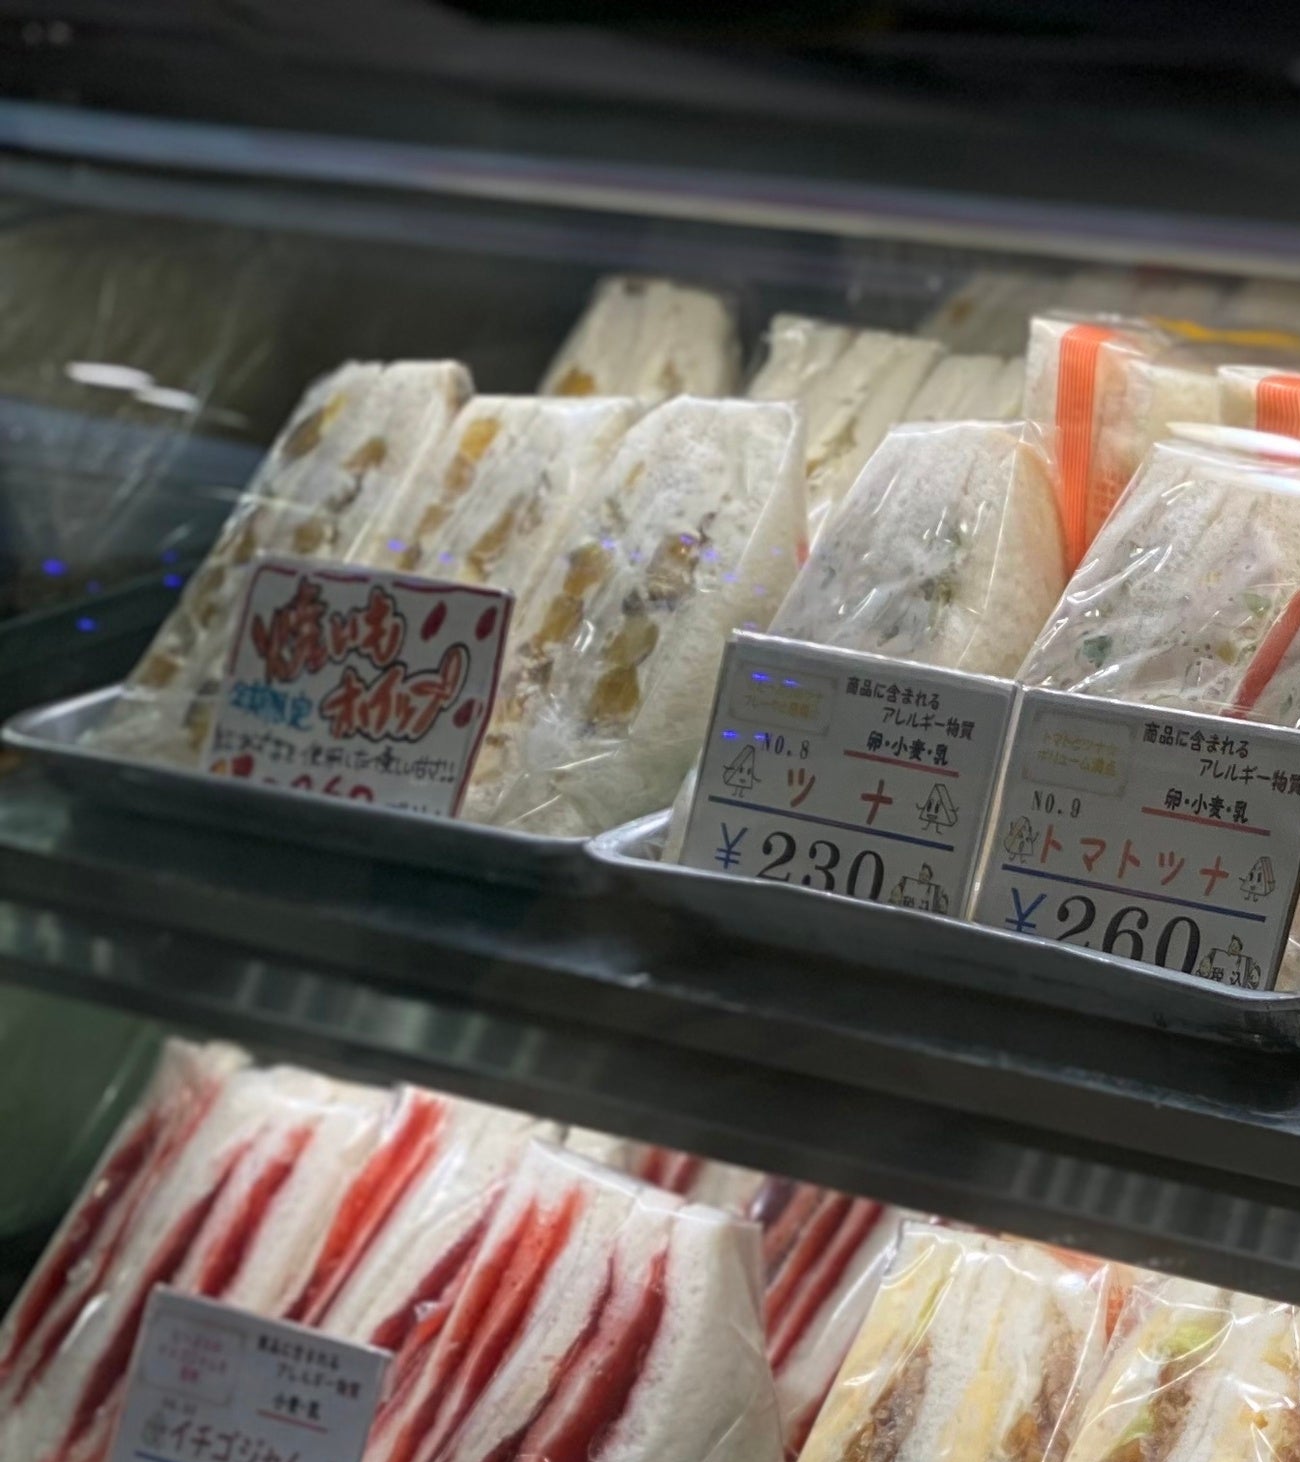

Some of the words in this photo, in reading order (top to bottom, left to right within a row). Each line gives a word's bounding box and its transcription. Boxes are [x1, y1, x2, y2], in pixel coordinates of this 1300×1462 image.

[846, 676, 940, 711] 商品に含まれる
[882, 705, 975, 740] アレルギー物質
[1143, 722, 1249, 759] 商品に含まれる
[866, 731, 949, 766] 卵・小麦・乳
[787, 767, 894, 825] ツナ
[1164, 787, 1249, 824] 卵・小麦・乳
[1039, 823, 1230, 897] トマトツナ
